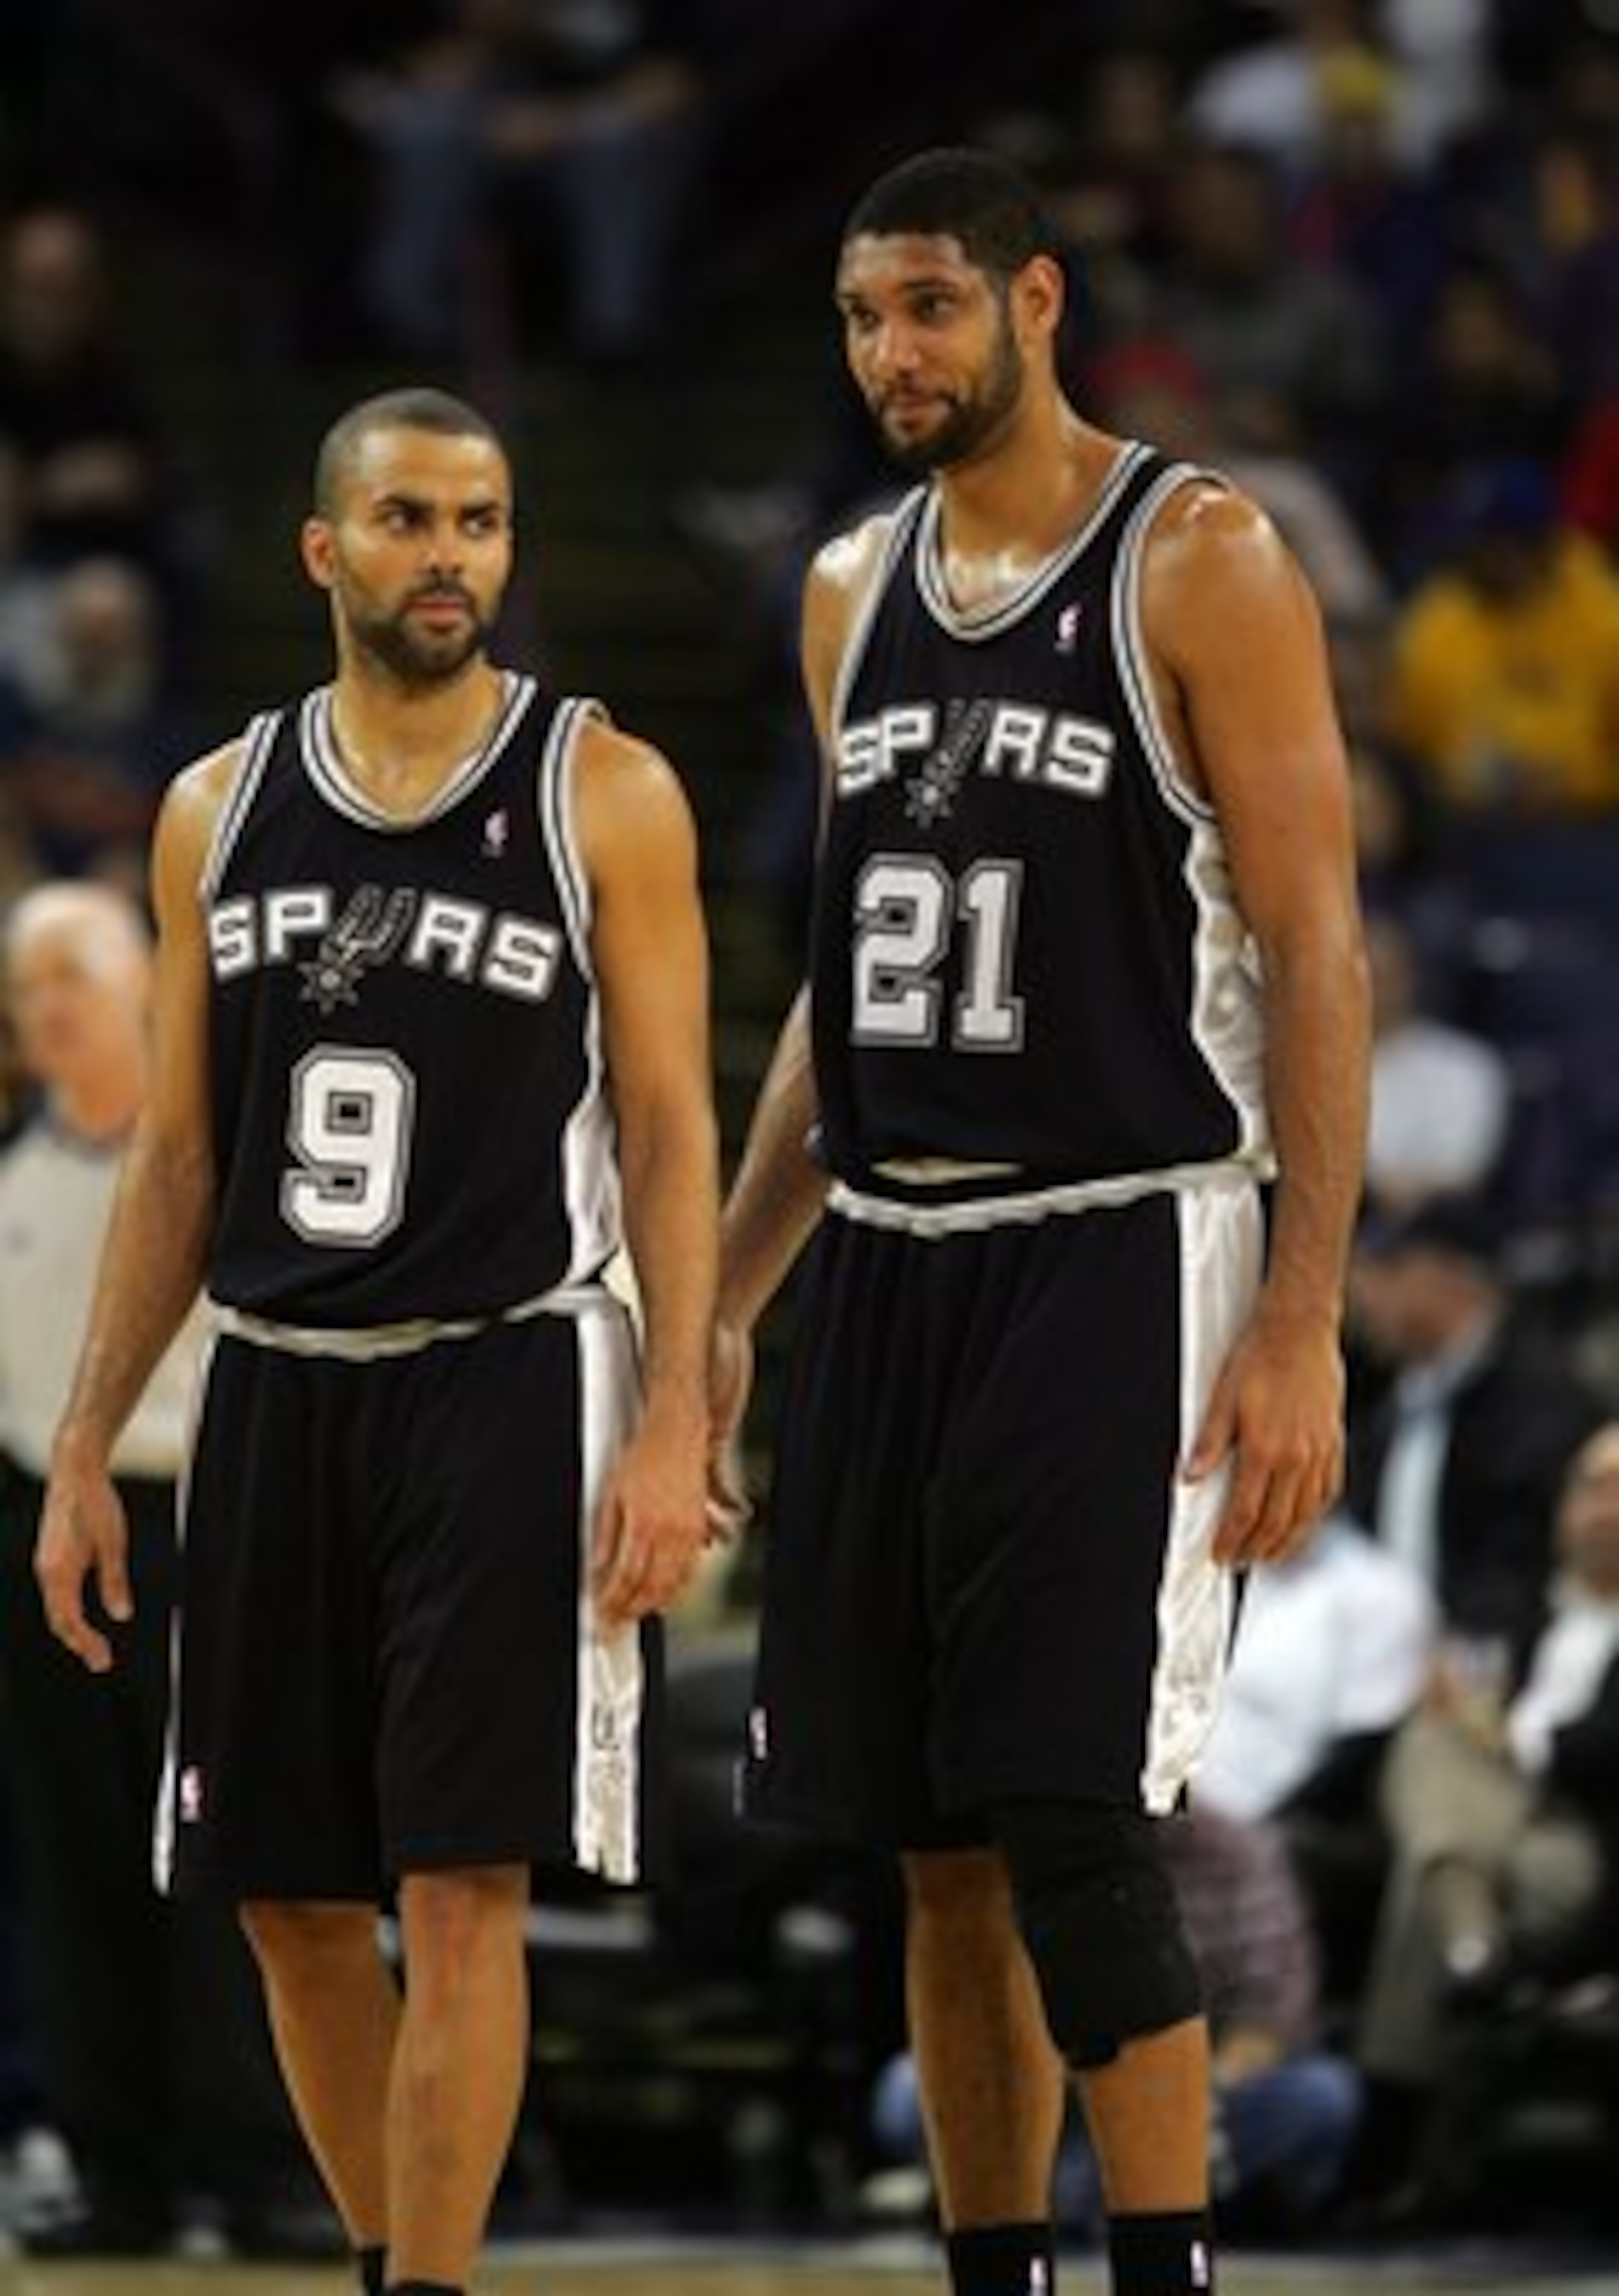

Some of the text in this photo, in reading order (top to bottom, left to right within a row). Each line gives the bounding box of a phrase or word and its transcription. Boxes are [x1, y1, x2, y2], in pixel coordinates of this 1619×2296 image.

[209, 884, 563, 1012] SPURS
[850, 852, 1025, 1053] 21
[278, 1041, 417, 1249] 9
